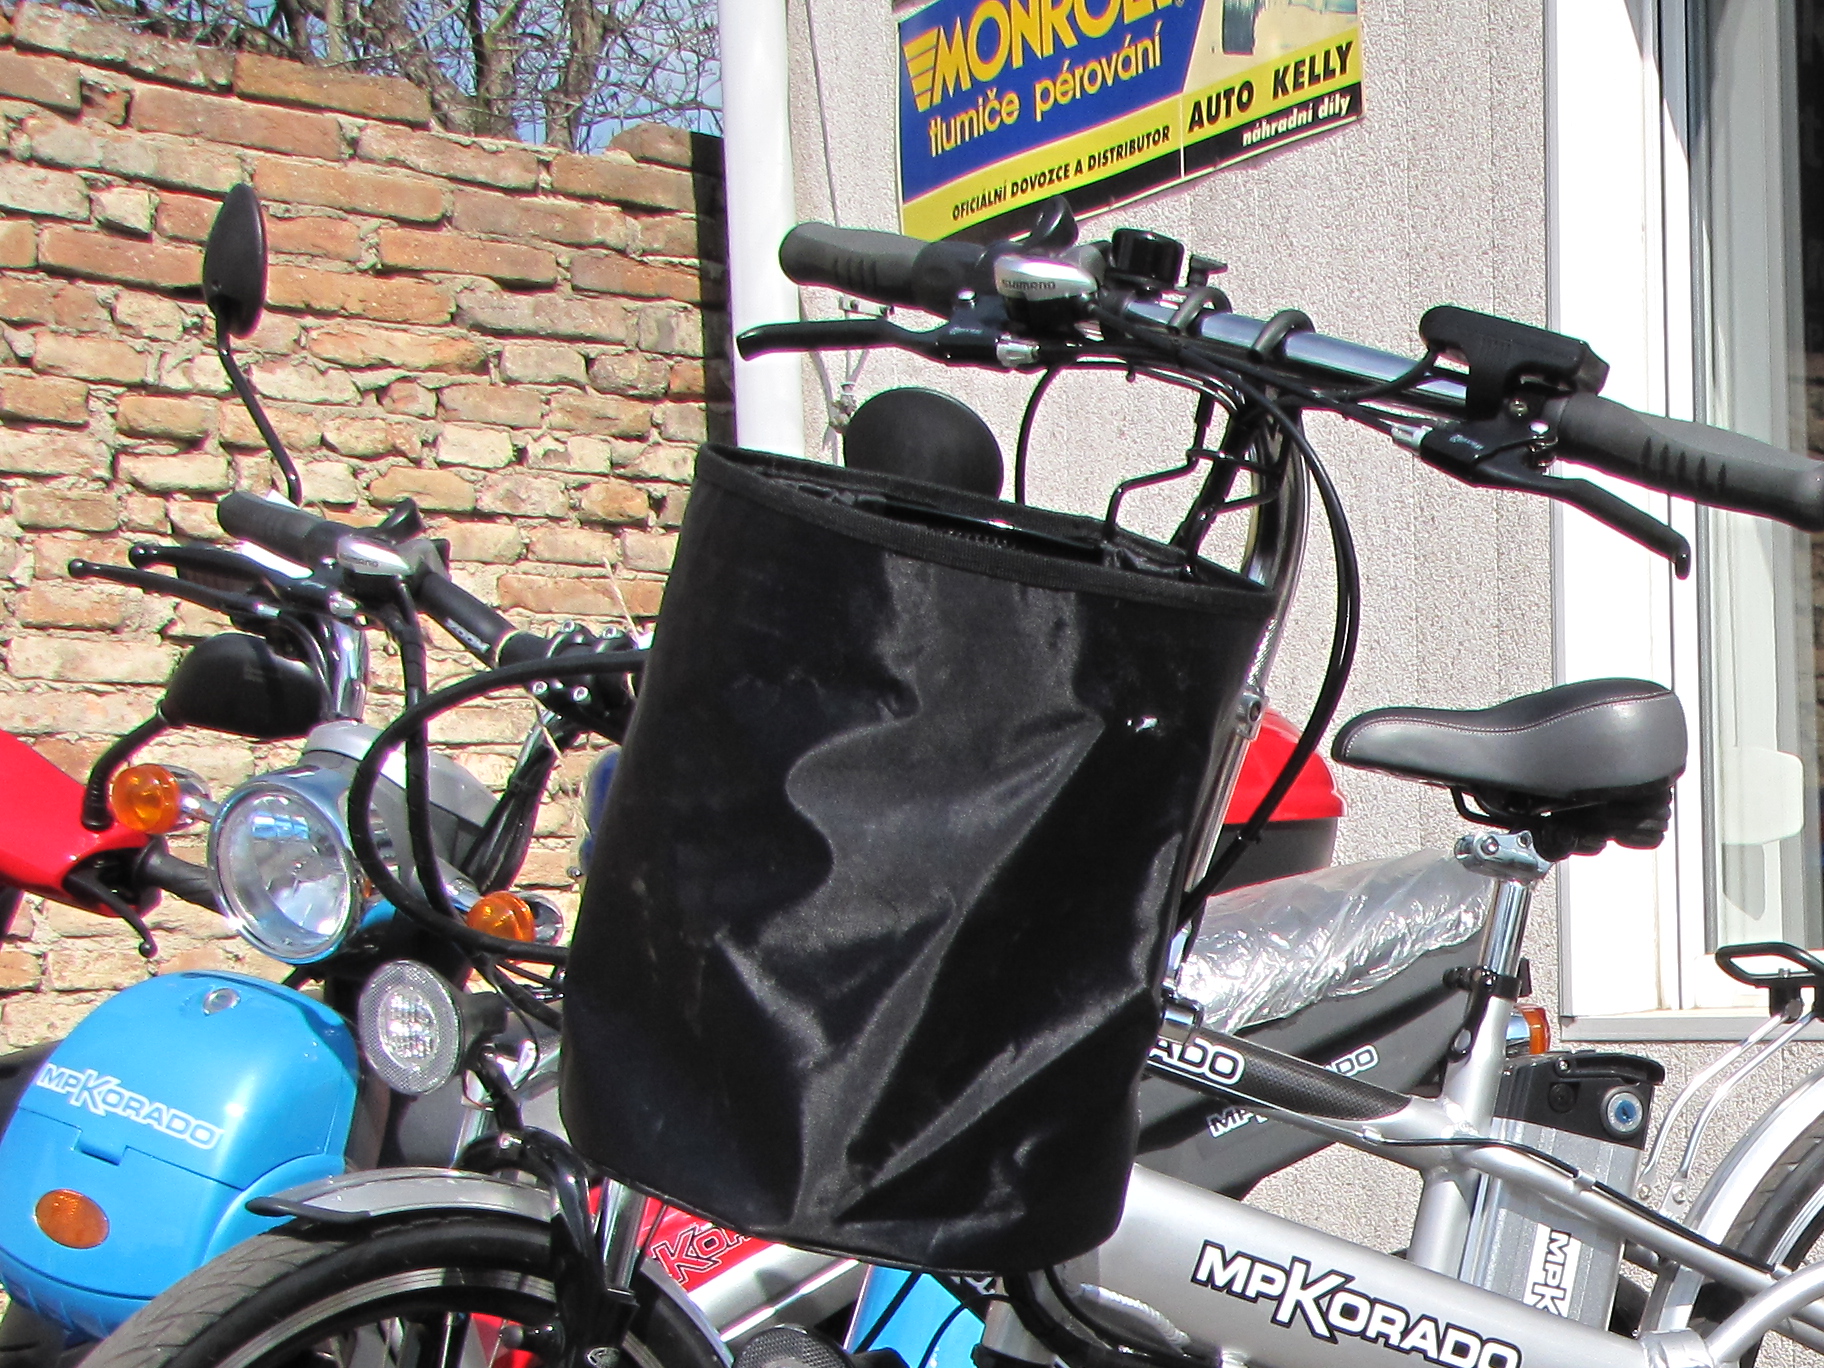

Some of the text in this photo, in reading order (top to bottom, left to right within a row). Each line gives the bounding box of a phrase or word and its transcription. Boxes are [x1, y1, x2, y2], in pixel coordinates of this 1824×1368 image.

[929, 20, 1164, 158] tlumiče pérování
[1187, 41, 1353, 133] AUTO KELLY
[1242, 93, 1351, 147] náhradní díly
[952, 125, 1170, 221] OFICIÁLNÍ DOVOZCE A DISTRIBUTOR
[1002, 278, 1055, 290] SHIMANO
